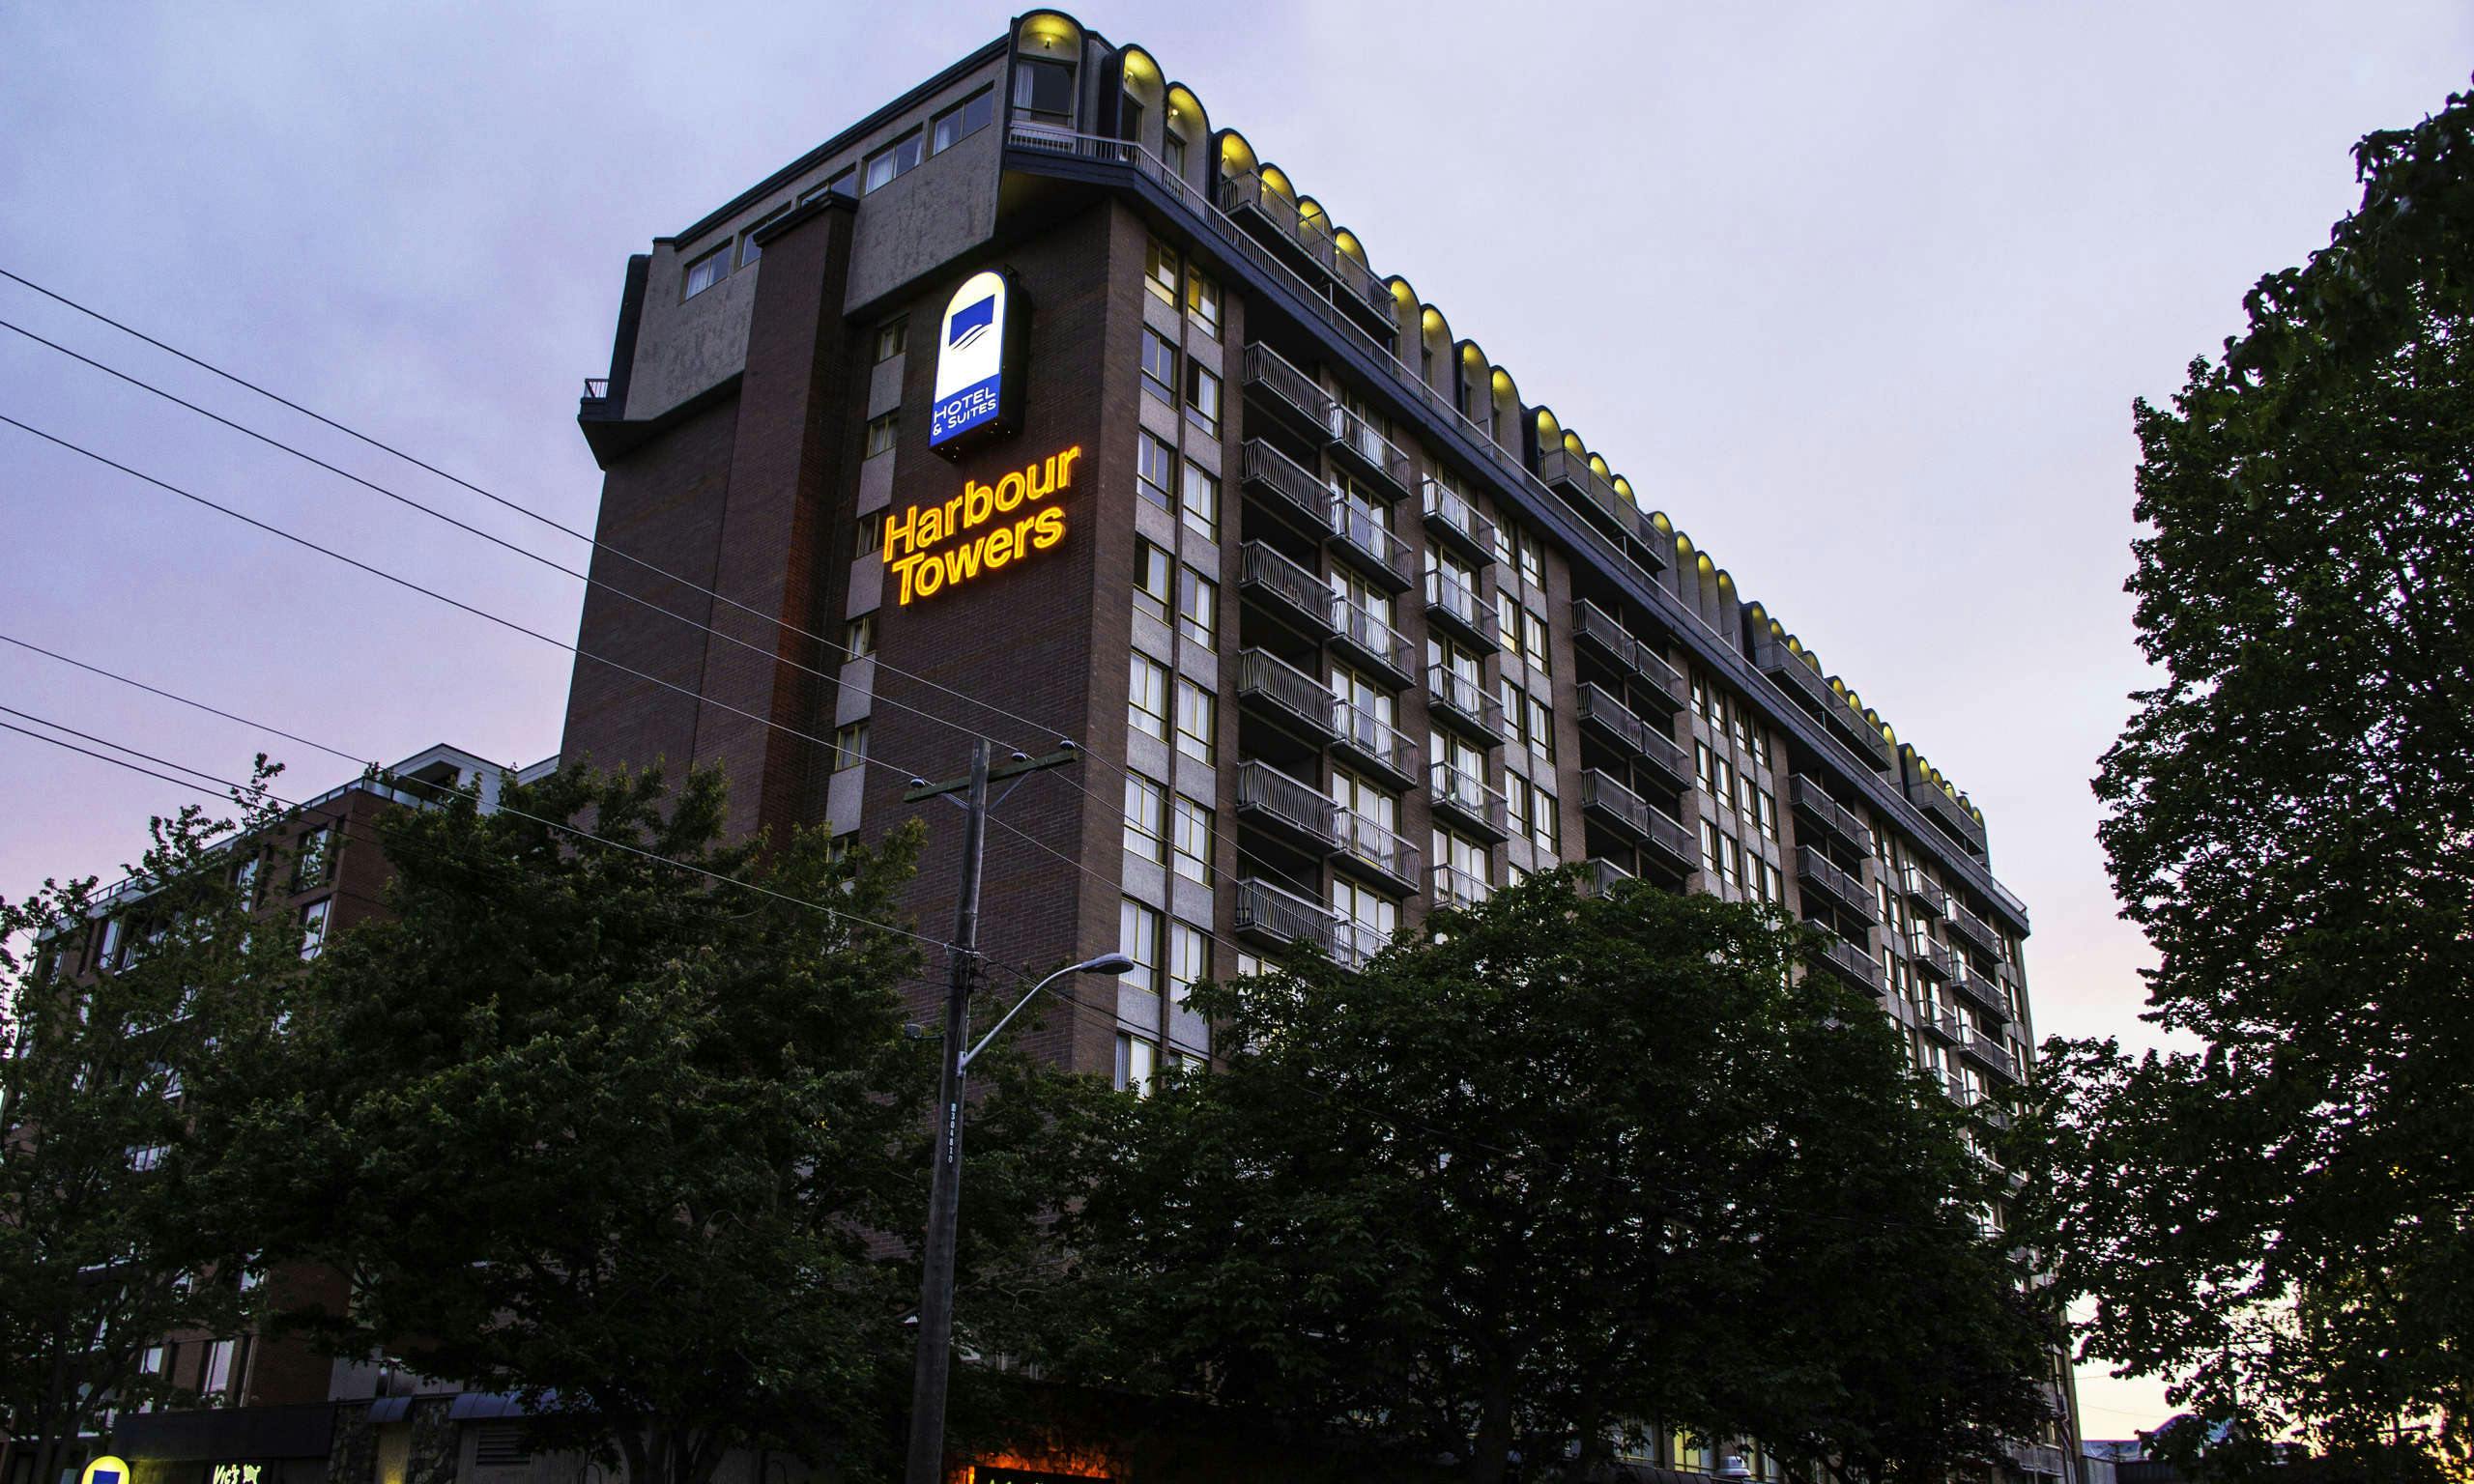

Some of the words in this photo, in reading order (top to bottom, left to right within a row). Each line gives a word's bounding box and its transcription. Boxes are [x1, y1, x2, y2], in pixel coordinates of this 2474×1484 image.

[933, 423, 942, 436] &
[947, 398, 996, 429] SUITES
[934, 386, 996, 424] HOTEL
[883, 445, 1081, 562] Harbour
[891, 506, 1067, 606] Towers
